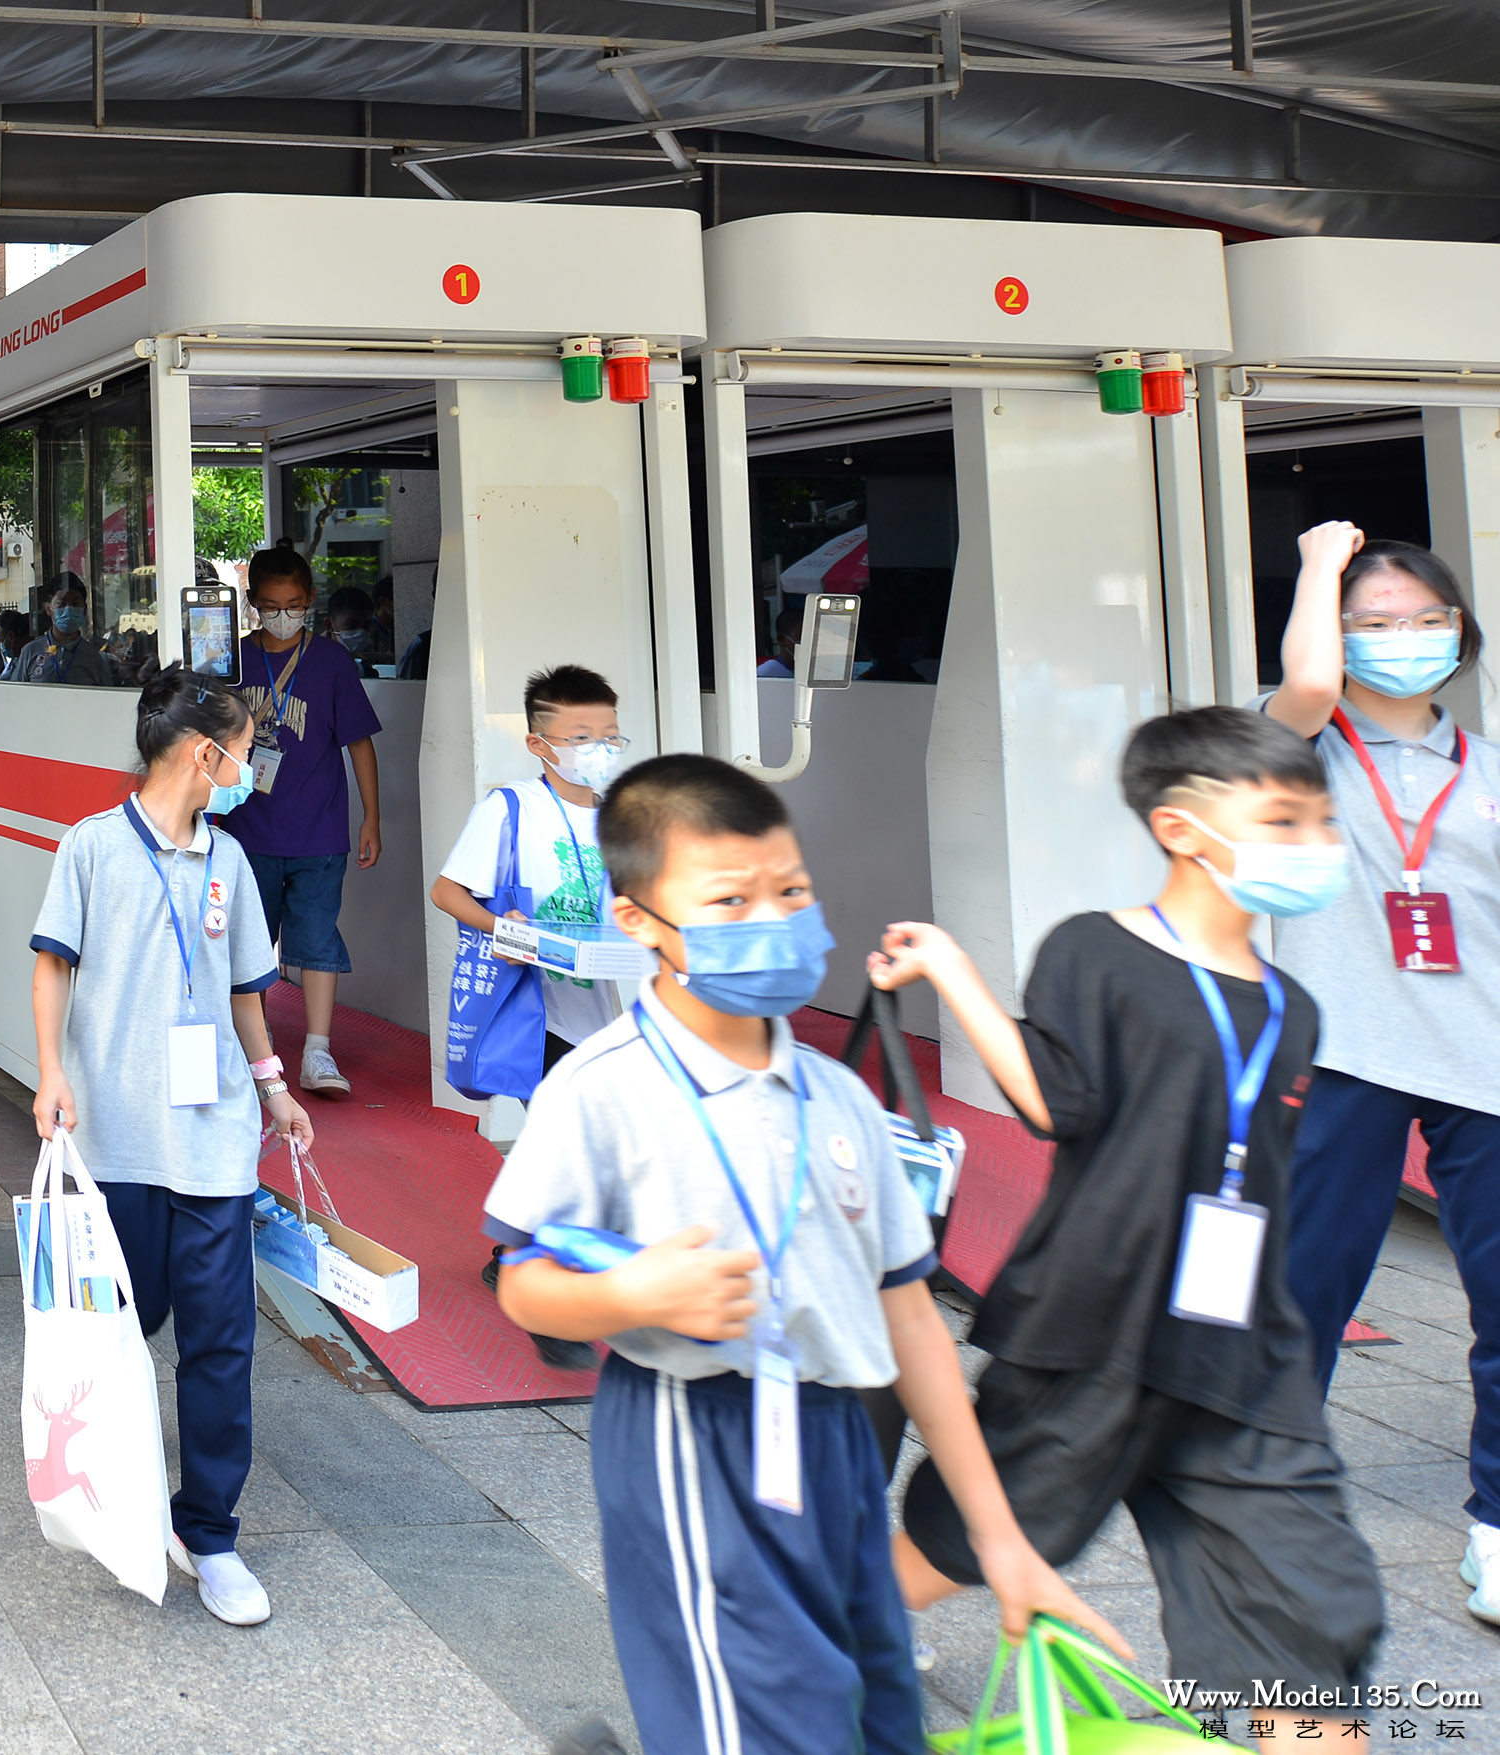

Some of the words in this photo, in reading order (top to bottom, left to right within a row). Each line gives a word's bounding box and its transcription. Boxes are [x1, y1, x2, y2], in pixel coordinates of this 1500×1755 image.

[455, 272, 468, 297] 1
[1004, 284, 1021, 308] 2
[23, 310, 60, 346] LONG
